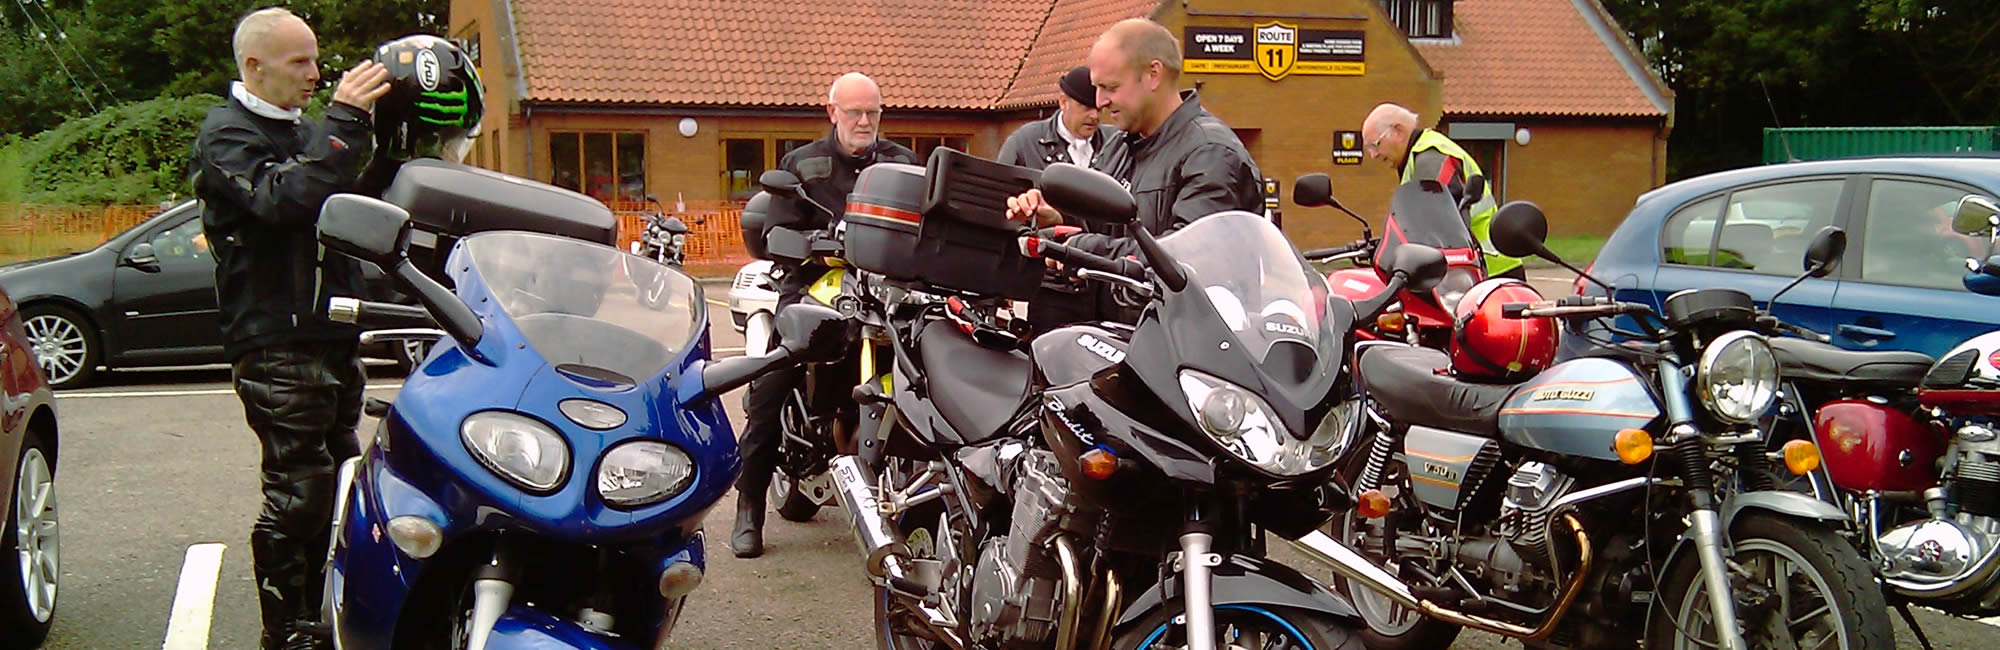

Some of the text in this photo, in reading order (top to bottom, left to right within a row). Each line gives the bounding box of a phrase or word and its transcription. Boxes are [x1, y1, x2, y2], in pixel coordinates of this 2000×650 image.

[1195, 34, 1244, 44] OPEN 7 DAYS
[1259, 32, 1291, 41] ROUTE
[1204, 44, 1235, 53] A WEEK
[1266, 49, 1283, 67] 11
[1265, 322, 1309, 337] SUZU
[1047, 395, 1095, 446] Bandit
